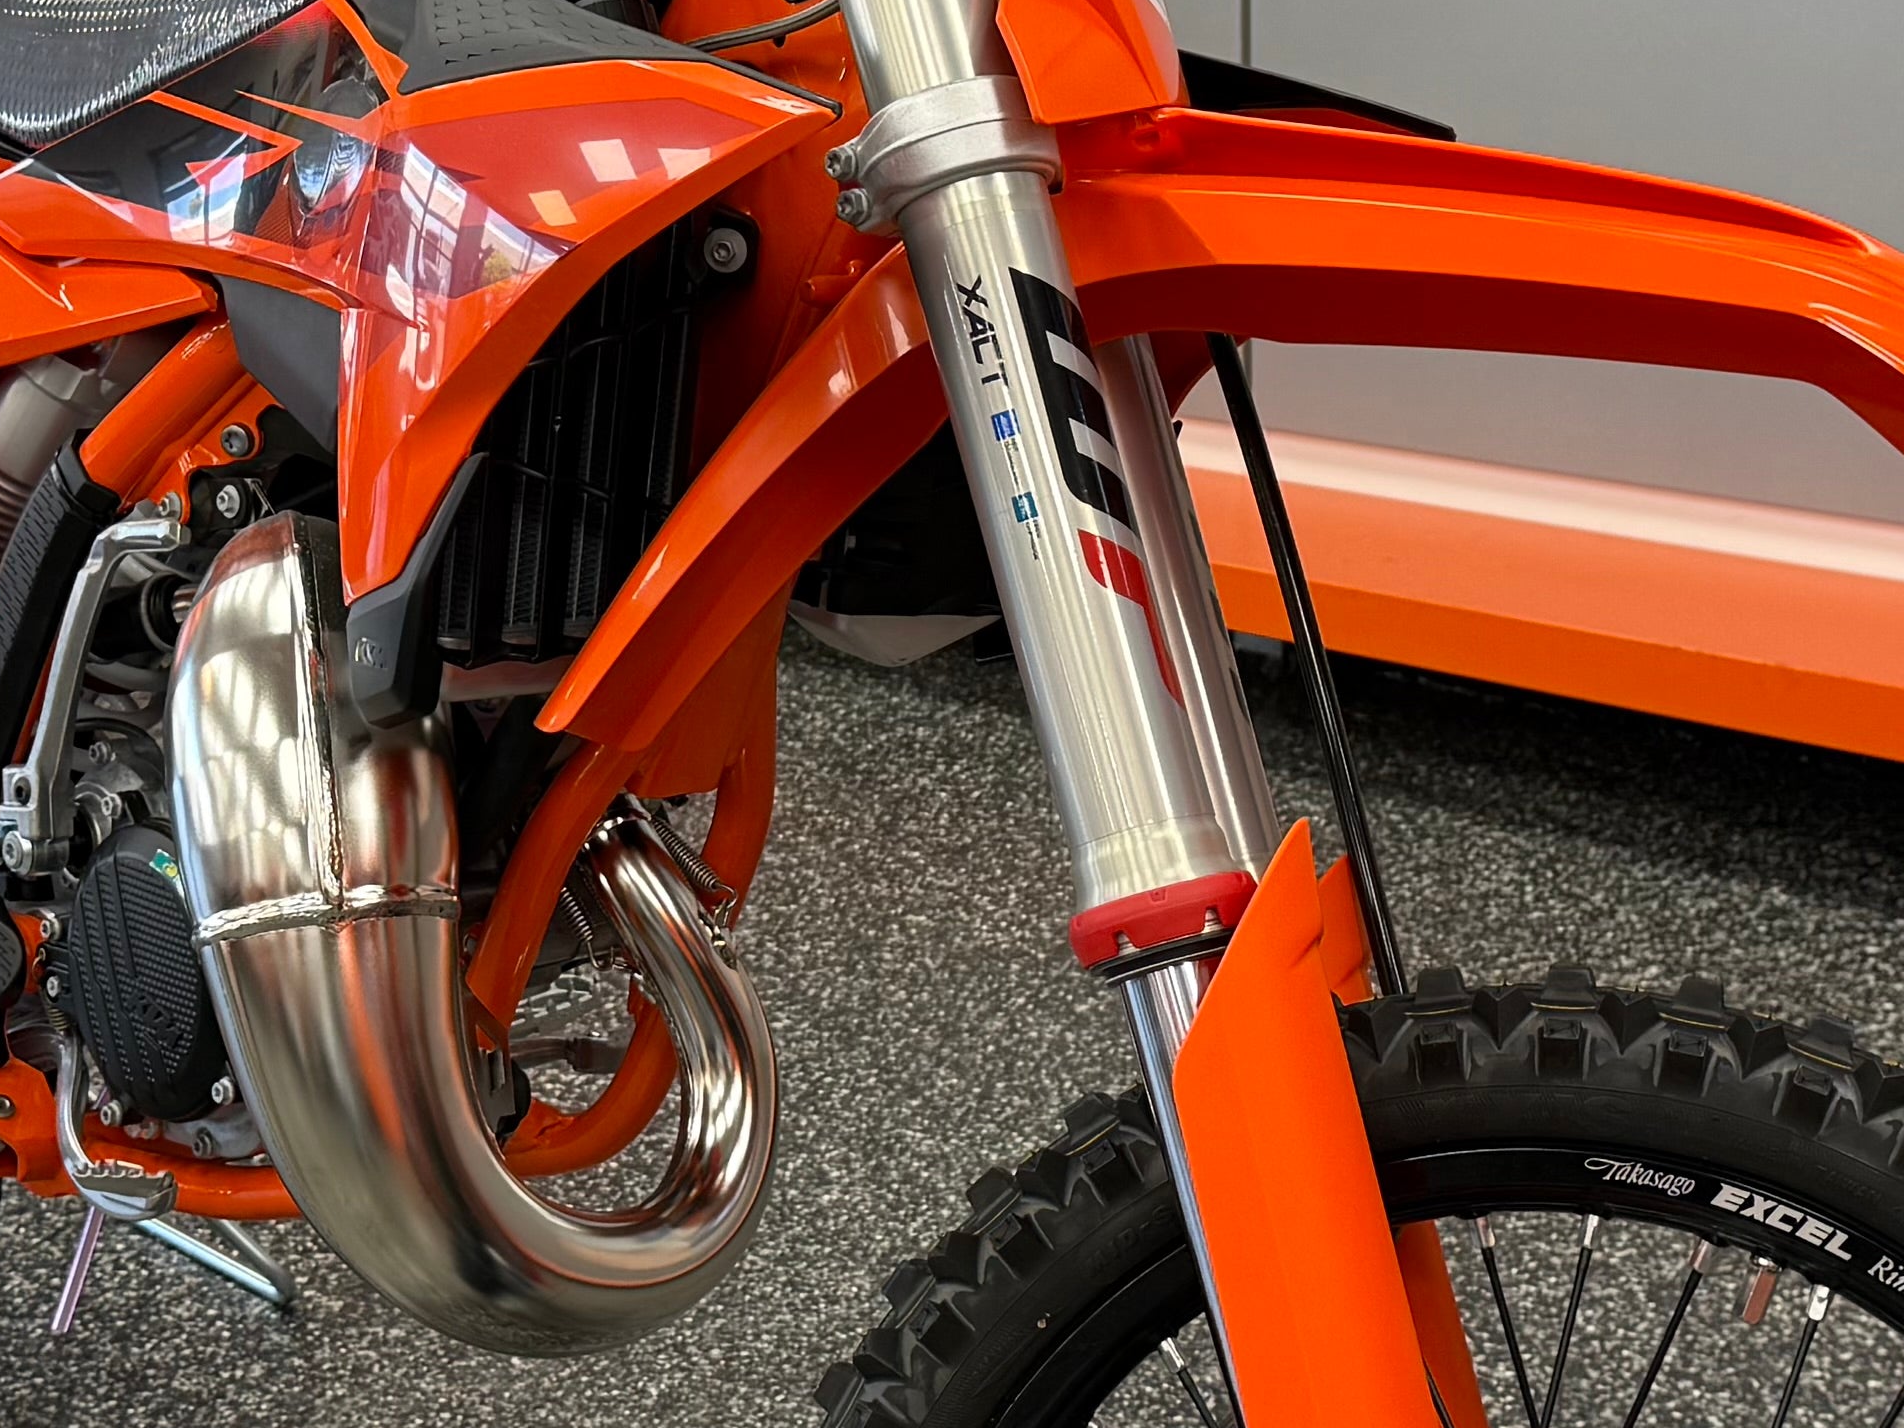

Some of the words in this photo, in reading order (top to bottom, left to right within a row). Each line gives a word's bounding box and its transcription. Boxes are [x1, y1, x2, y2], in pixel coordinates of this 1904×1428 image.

[955, 273, 1011, 390] XACT
[1584, 1157, 1696, 1197] Takasago
[1709, 1182, 1853, 1261] EXCEL
